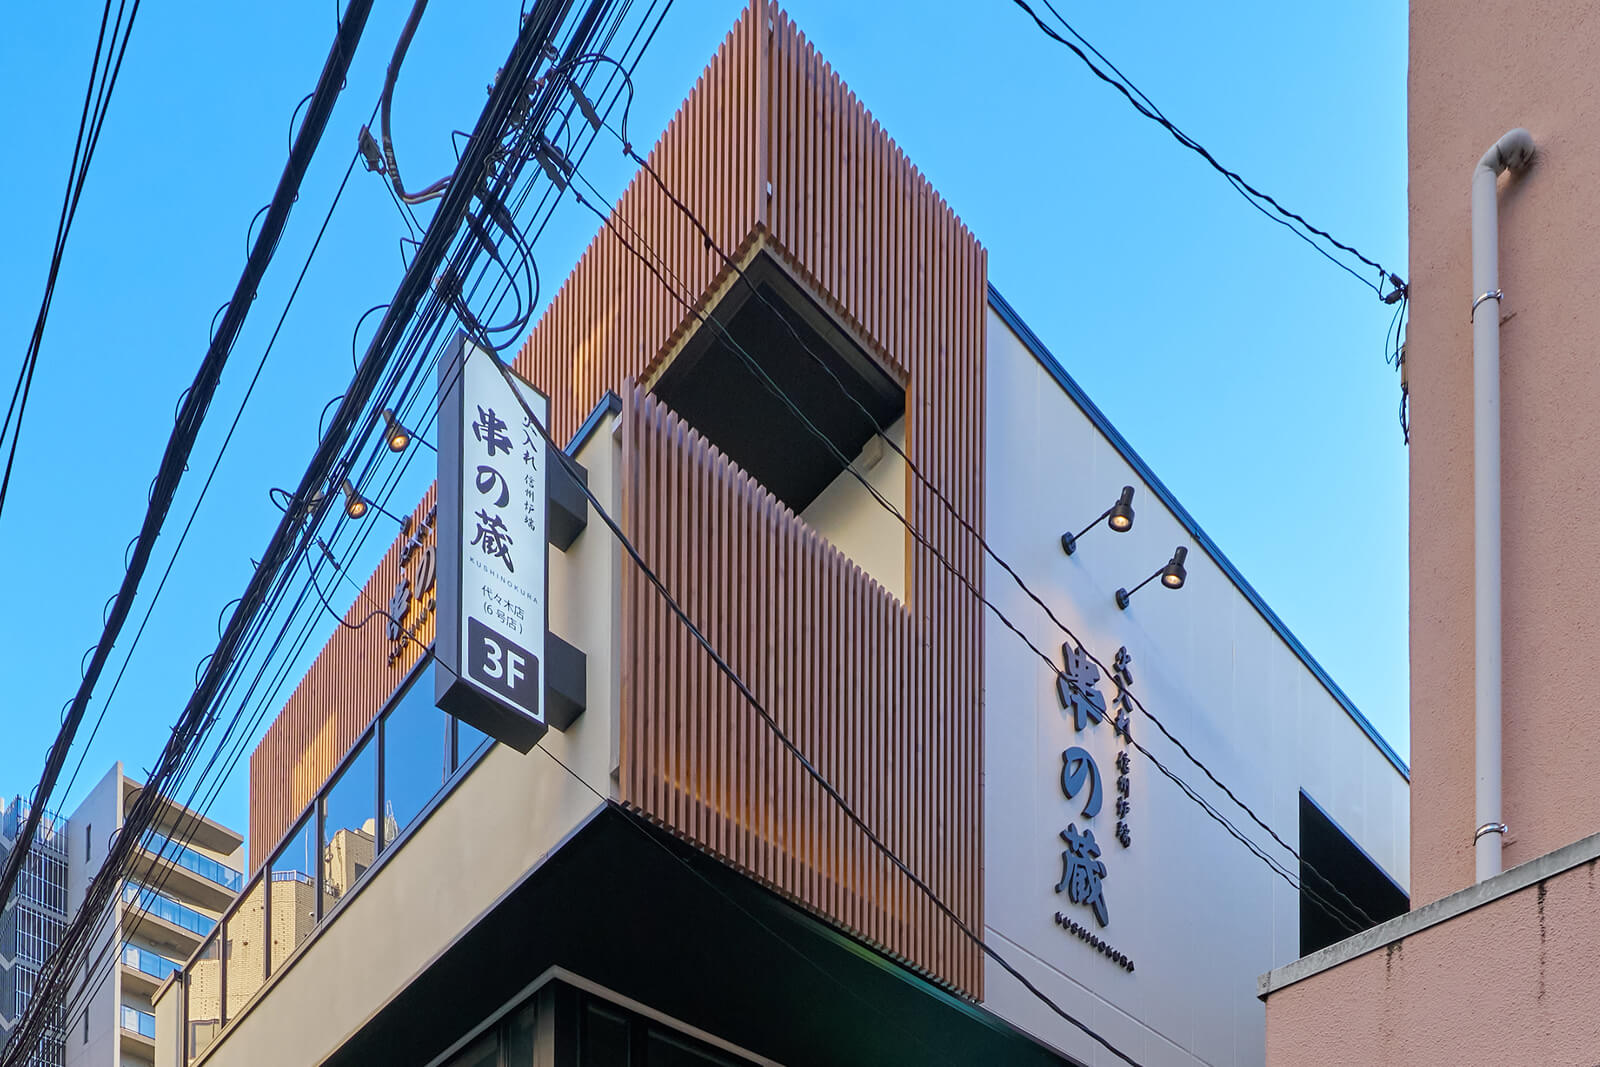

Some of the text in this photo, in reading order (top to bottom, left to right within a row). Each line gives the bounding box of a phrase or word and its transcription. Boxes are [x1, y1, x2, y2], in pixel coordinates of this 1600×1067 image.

[471, 404, 514, 573] 串の蔵
[469, 556, 539, 604] KUSHINOKURA
[481, 584, 525, 621] 代々木店
[482, 637, 526, 689] 3F
[1055, 641, 1109, 928] 串の蔵
[1054, 911, 1135, 973] KUSHINOKURA
